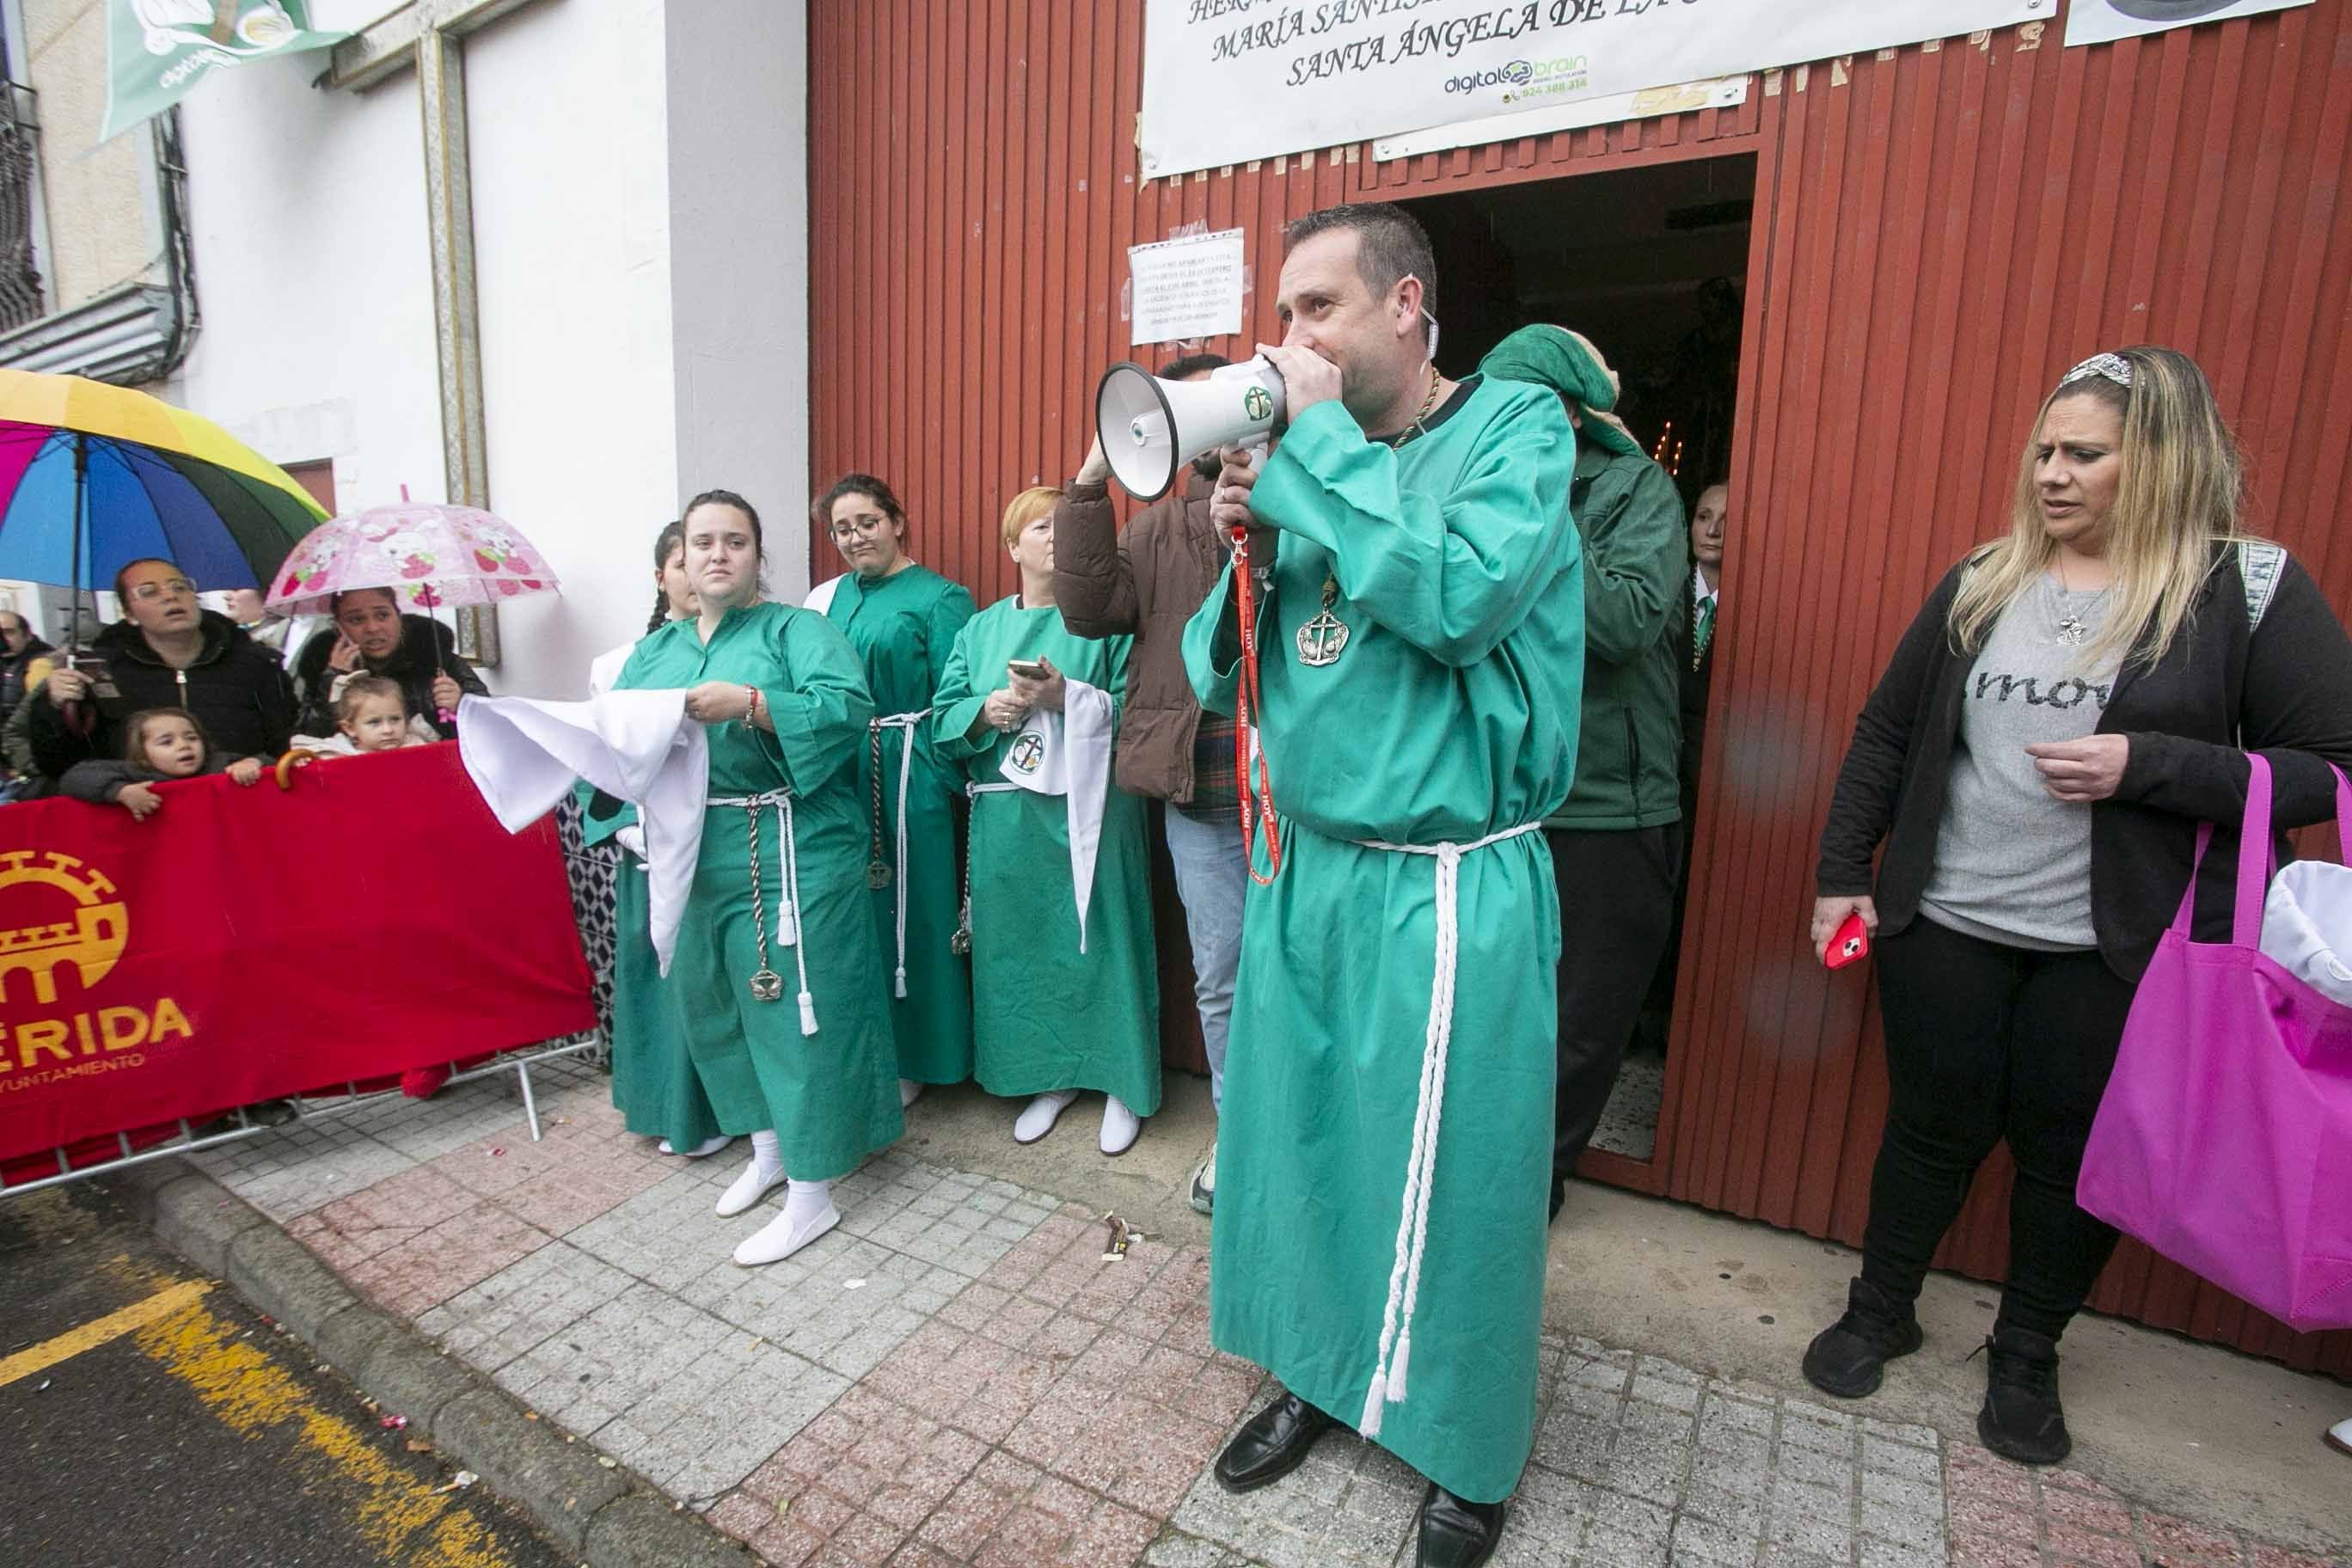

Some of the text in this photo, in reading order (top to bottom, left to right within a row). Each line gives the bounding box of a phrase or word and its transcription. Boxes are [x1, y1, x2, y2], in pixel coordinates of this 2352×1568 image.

[1212, 8, 1304, 61] MARÍA
[1286, 34, 1386, 86] SANTA
[1389, 1, 1540, 64] ÁNGELA
[1549, 0, 1607, 28] DE
[1444, 66, 1505, 95] digital
[1534, 55, 1589, 76] brain
[1262, 795, 1271, 816] HOY
